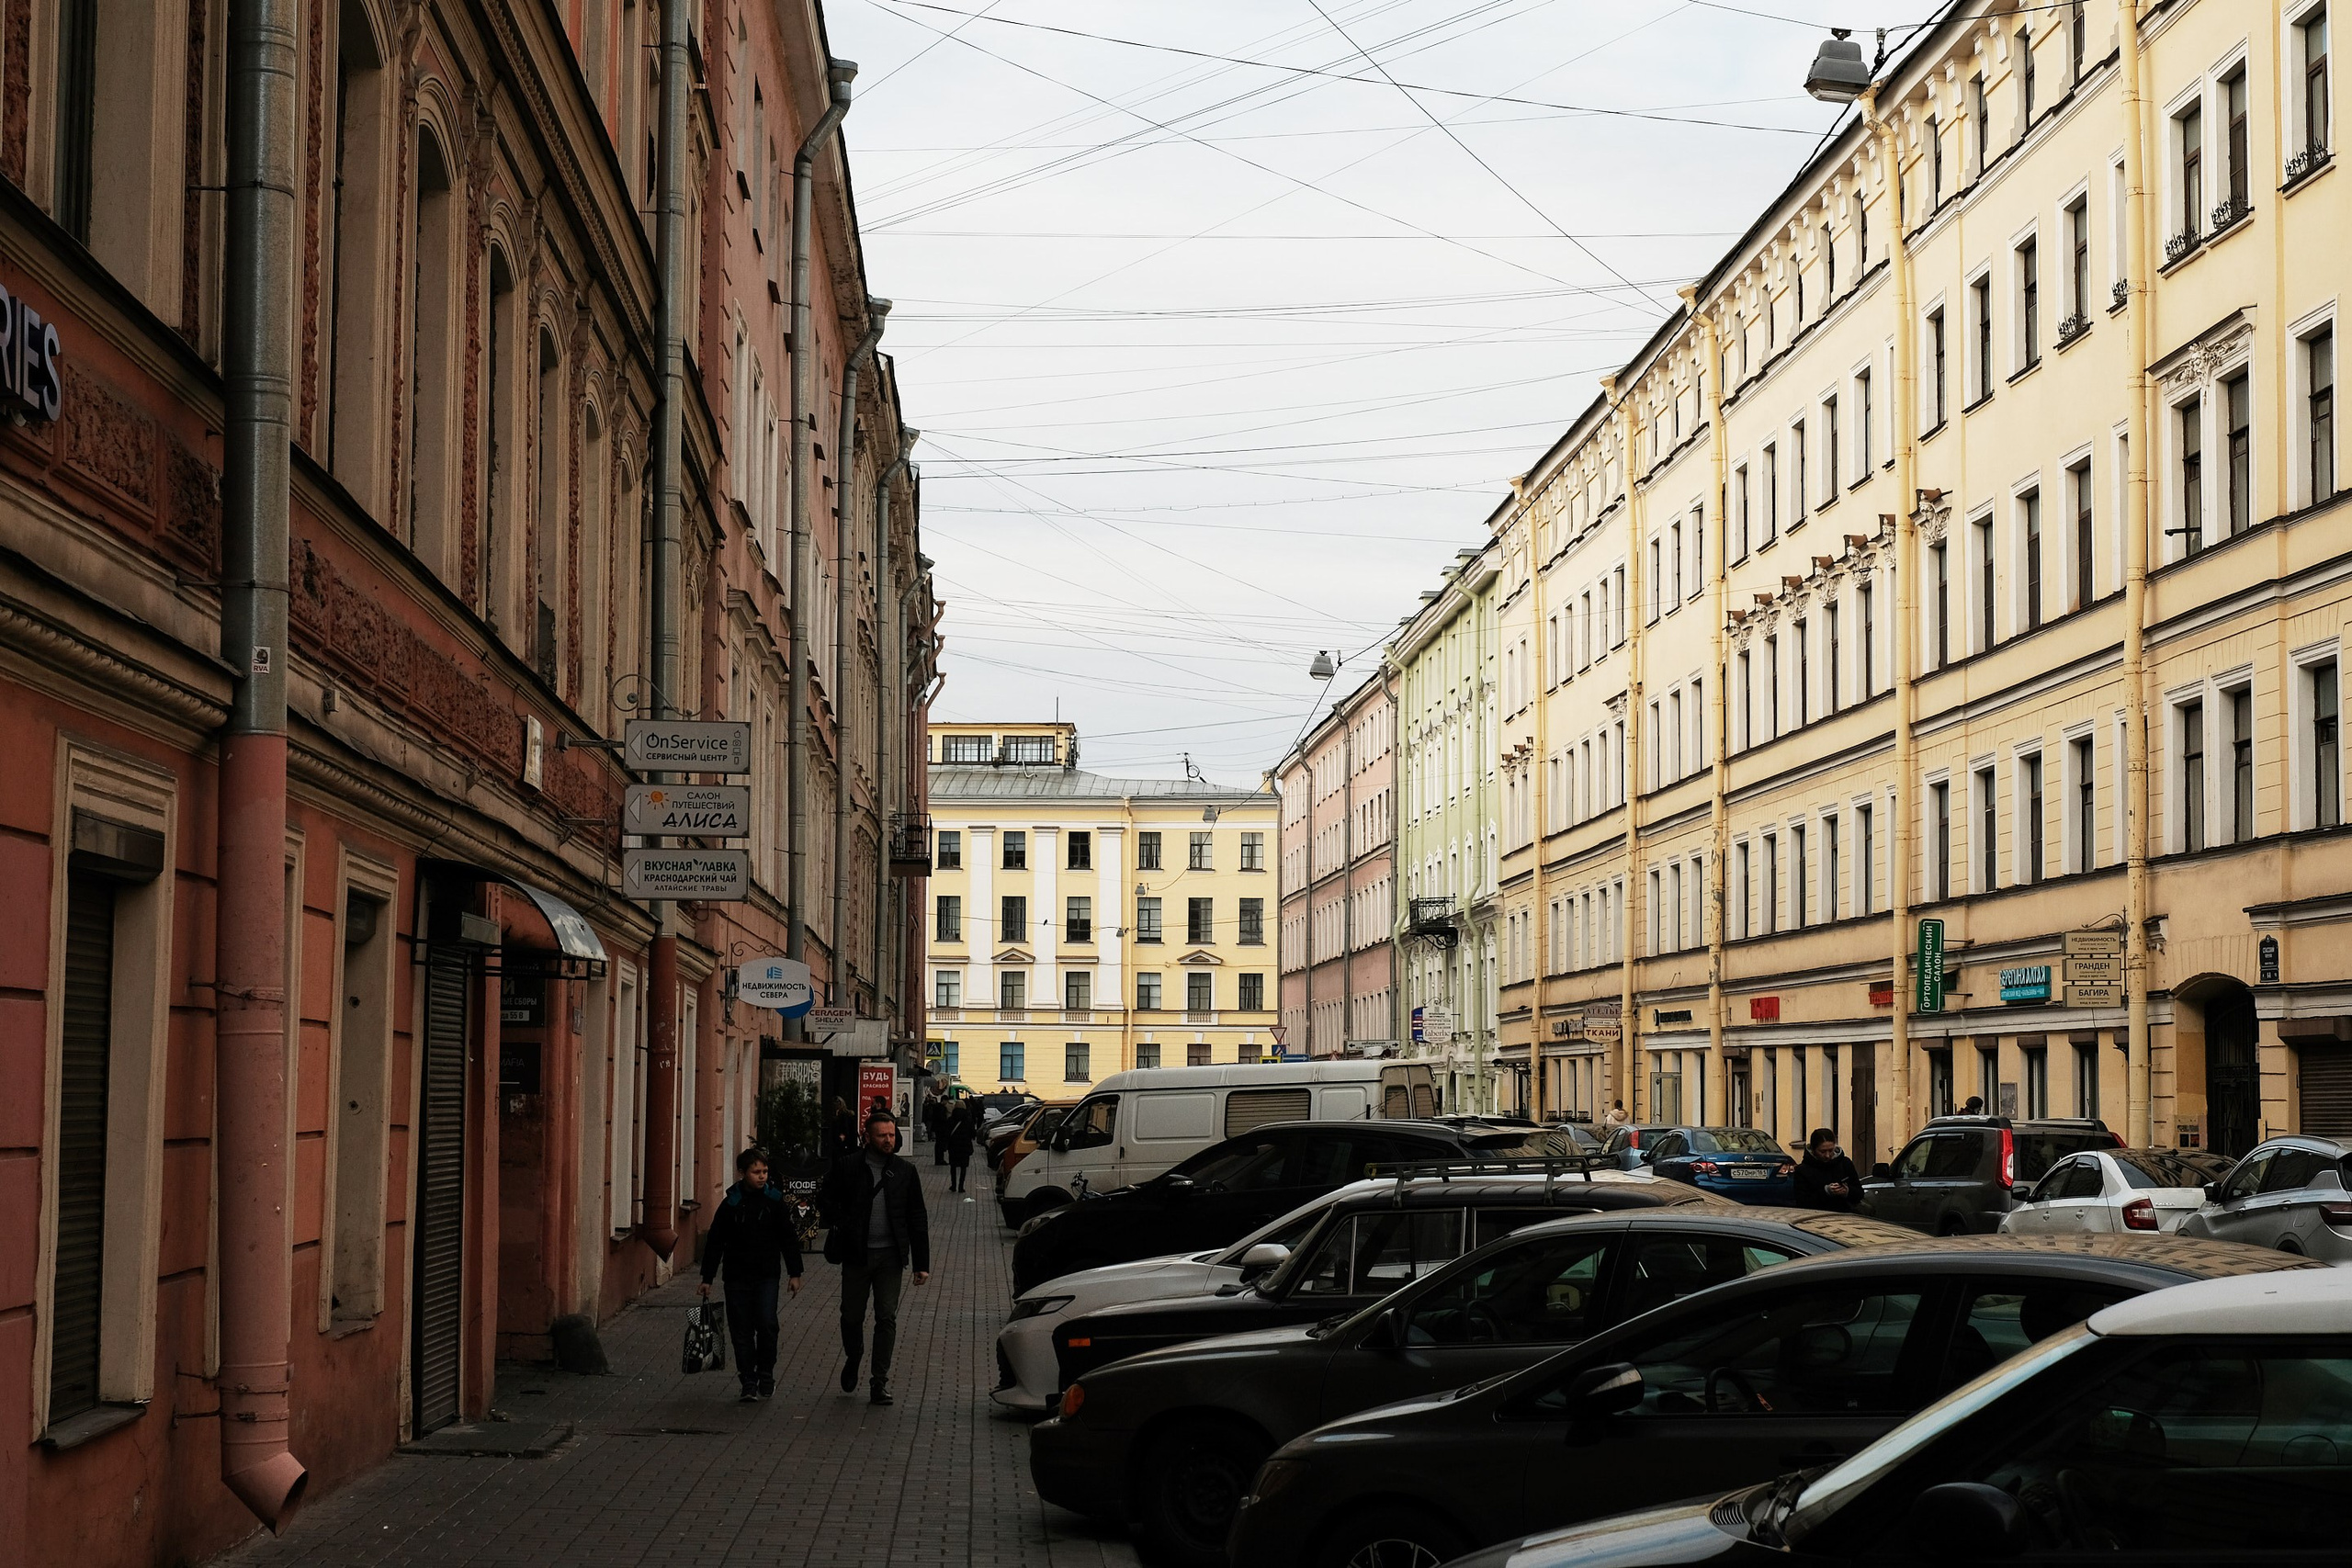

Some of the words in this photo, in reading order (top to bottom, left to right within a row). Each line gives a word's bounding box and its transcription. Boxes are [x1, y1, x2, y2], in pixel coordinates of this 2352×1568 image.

[646, 732, 729, 750] OnService
[646, 752, 697, 761] СЕРВИСНЫЙ
[700, 754, 728, 762] ЦЕНТР
[686, 792, 720, 800] САЛОН
[672, 800, 735, 810] ПУТЕШЕСТВИЙ
[662, 812, 738, 829] АЛИСА
[644, 861, 693, 872] ВКУСНАЯ
[697, 861, 737, 872] ЛАВКА
[644, 874, 718, 884] КРАСНОДАРСКИЙ
[720, 874, 737, 883] ЧАЙ
[1922, 925, 1933, 1008] ОРТОПЕДИЧЕСКИЙ
[1933, 952, 1941, 983] САЛОН
[742, 982, 807, 990] НЕДВИЖИМОСТЬ
[514, 998, 537, 1006] СБОРЫ
[863, 1072, 889, 1081] БУДЬ
